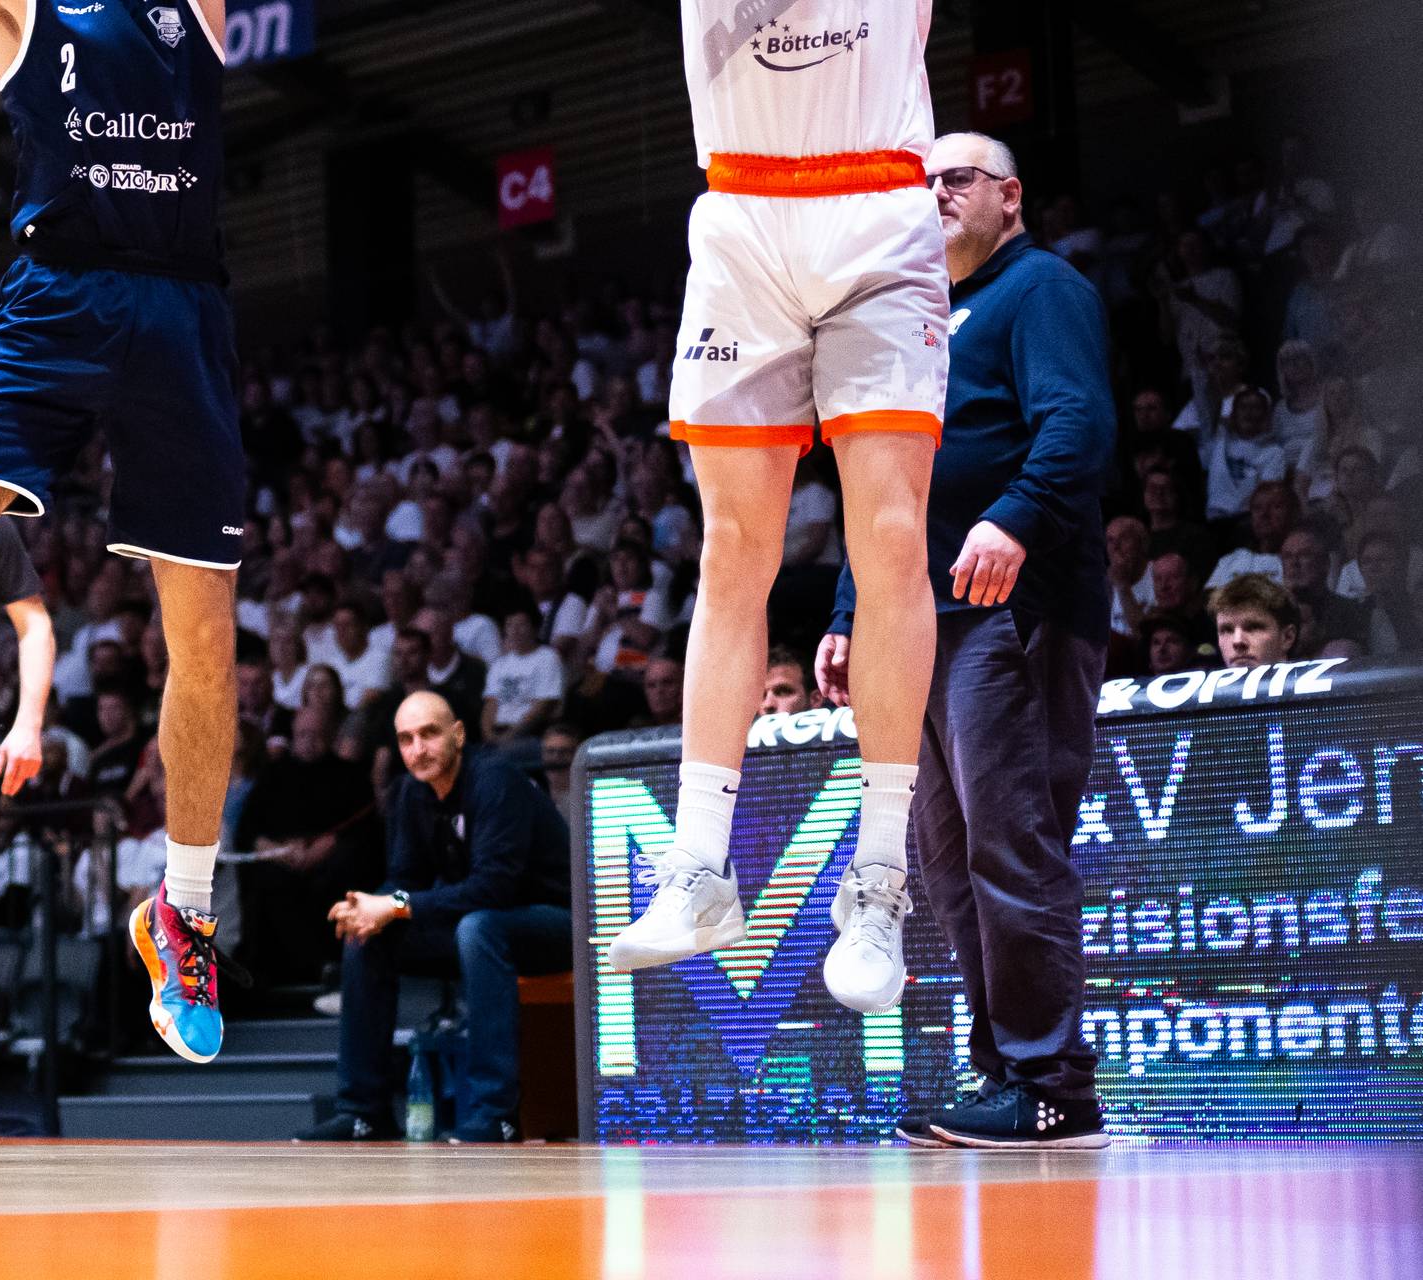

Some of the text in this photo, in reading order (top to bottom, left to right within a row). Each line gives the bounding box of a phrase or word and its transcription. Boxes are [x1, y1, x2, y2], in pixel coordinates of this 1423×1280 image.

[60, 43, 76, 93] 2
[977, 70, 1023, 110] F2
[500, 166, 552, 210] C4
[706, 341, 738, 362] asi
[1096, 678, 1141, 714] &
[1146, 657, 1349, 709] OPITZ
